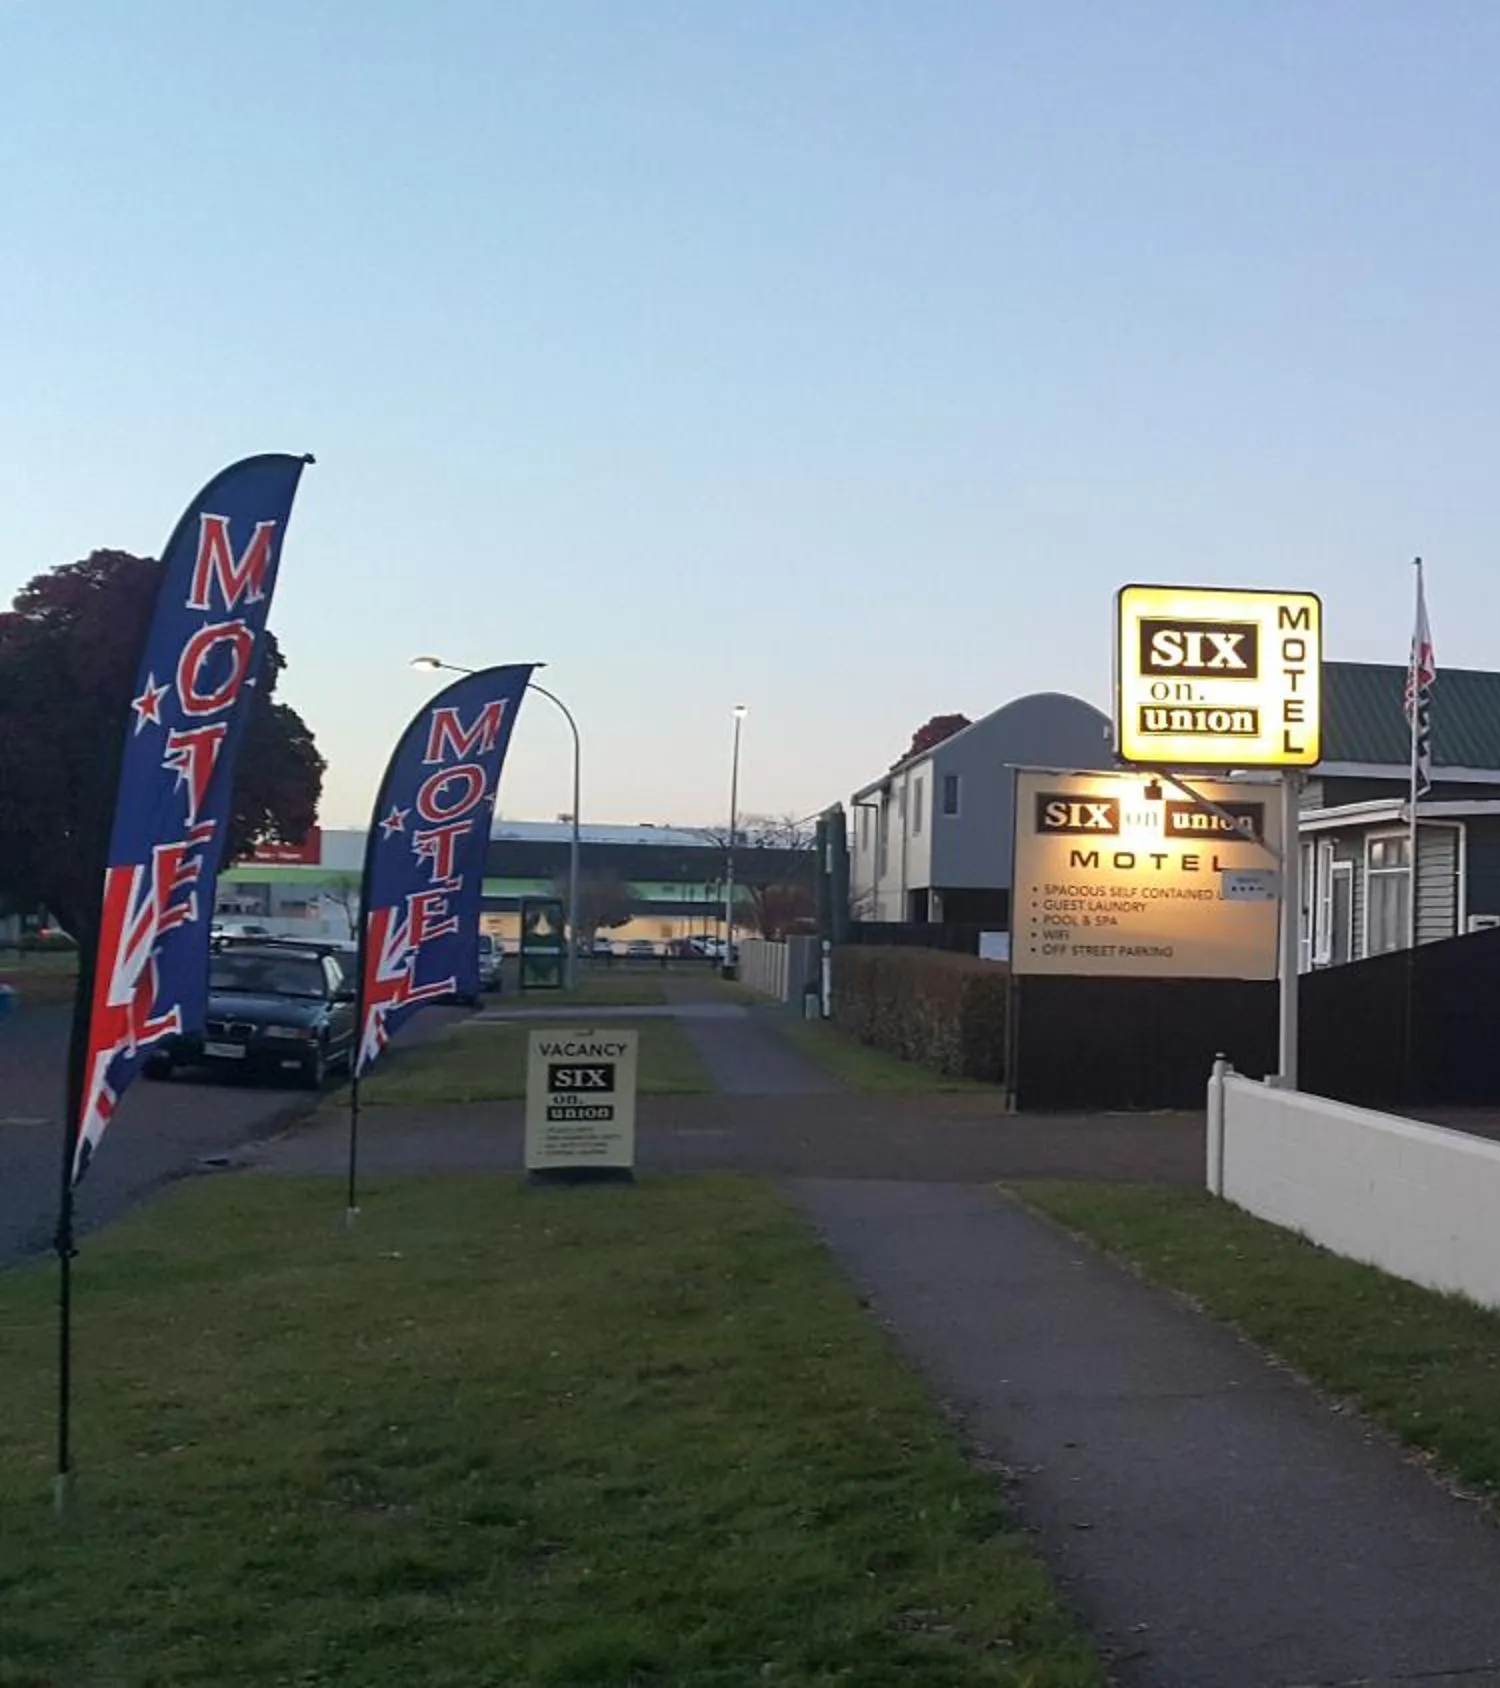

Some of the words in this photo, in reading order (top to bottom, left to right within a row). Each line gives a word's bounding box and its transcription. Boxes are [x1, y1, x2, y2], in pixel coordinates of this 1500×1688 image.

[1150, 628, 1248, 670] SIX
[1278, 606, 1310, 754] MOTEL
[1144, 708, 1254, 732] union
[124, 512, 277, 1056] MOTEL
[1045, 801, 1113, 829] SIX
[396, 699, 508, 1015] MOTEL
[1070, 850, 1230, 872] MOTEL
[1043, 884, 1106, 898] SPACIOUS
[1110, 886, 1138, 899] SELF
[1141, 887, 1213, 901] CONTAINED
[1043, 899, 1085, 911] GUEST
[1088, 901, 1147, 913] LAUNDRY
[1043, 914, 1078, 926] POOL
[1095, 916, 1118, 926] SPA
[1042, 944, 1067, 956] OFF
[1071, 945, 1117, 957] STREET
[1119, 946, 1174, 958] PARKING
[538, 1042, 628, 1057] VACANCY
[554, 1068, 608, 1088] SIX
[551, 1107, 610, 1119] union
